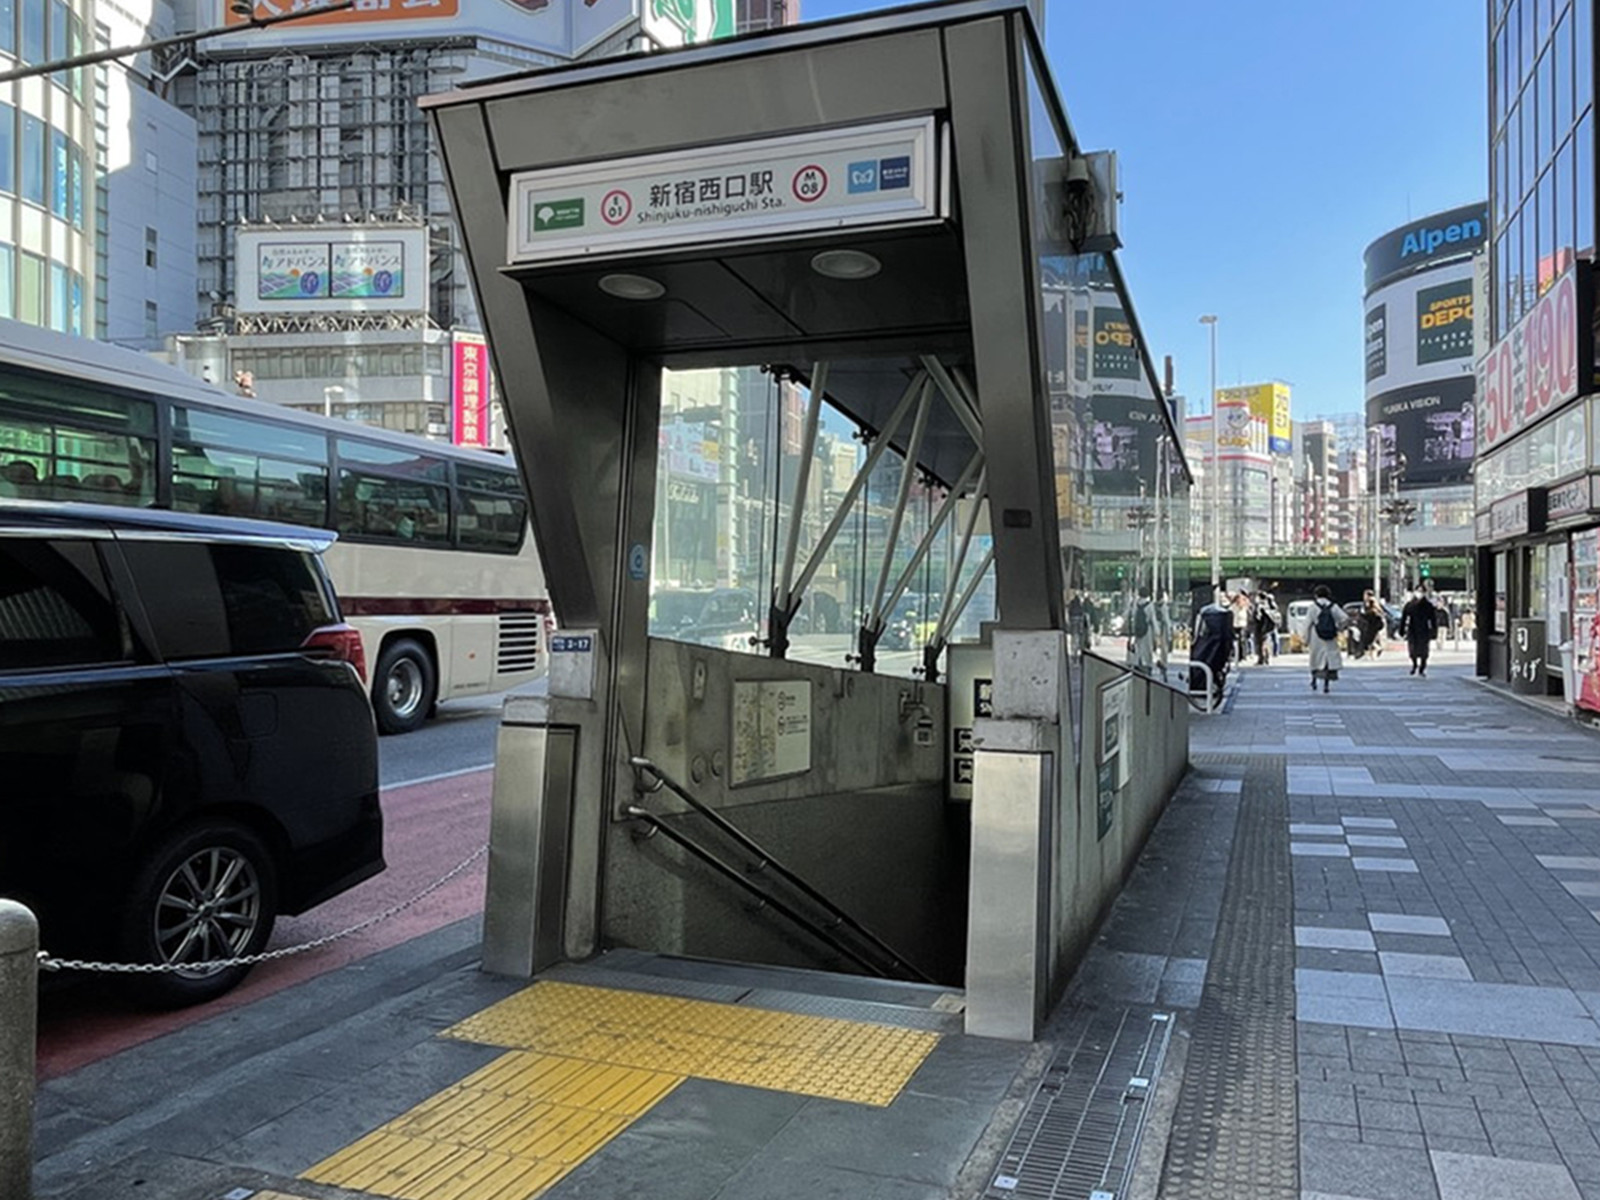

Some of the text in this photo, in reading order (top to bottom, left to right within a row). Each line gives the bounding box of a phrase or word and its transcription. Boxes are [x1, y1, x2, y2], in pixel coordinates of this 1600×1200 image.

[804, 171, 816, 181] M
[650, 170, 774, 208] 新宿西口駅
[801, 182, 818, 195] 08
[608, 206, 623, 218] 01
[637, 196, 786, 224] Shinjuku-nishiguchi Sta.
[1401, 219, 1481, 258] Alpen
[1430, 295, 1472, 311] SPORTS
